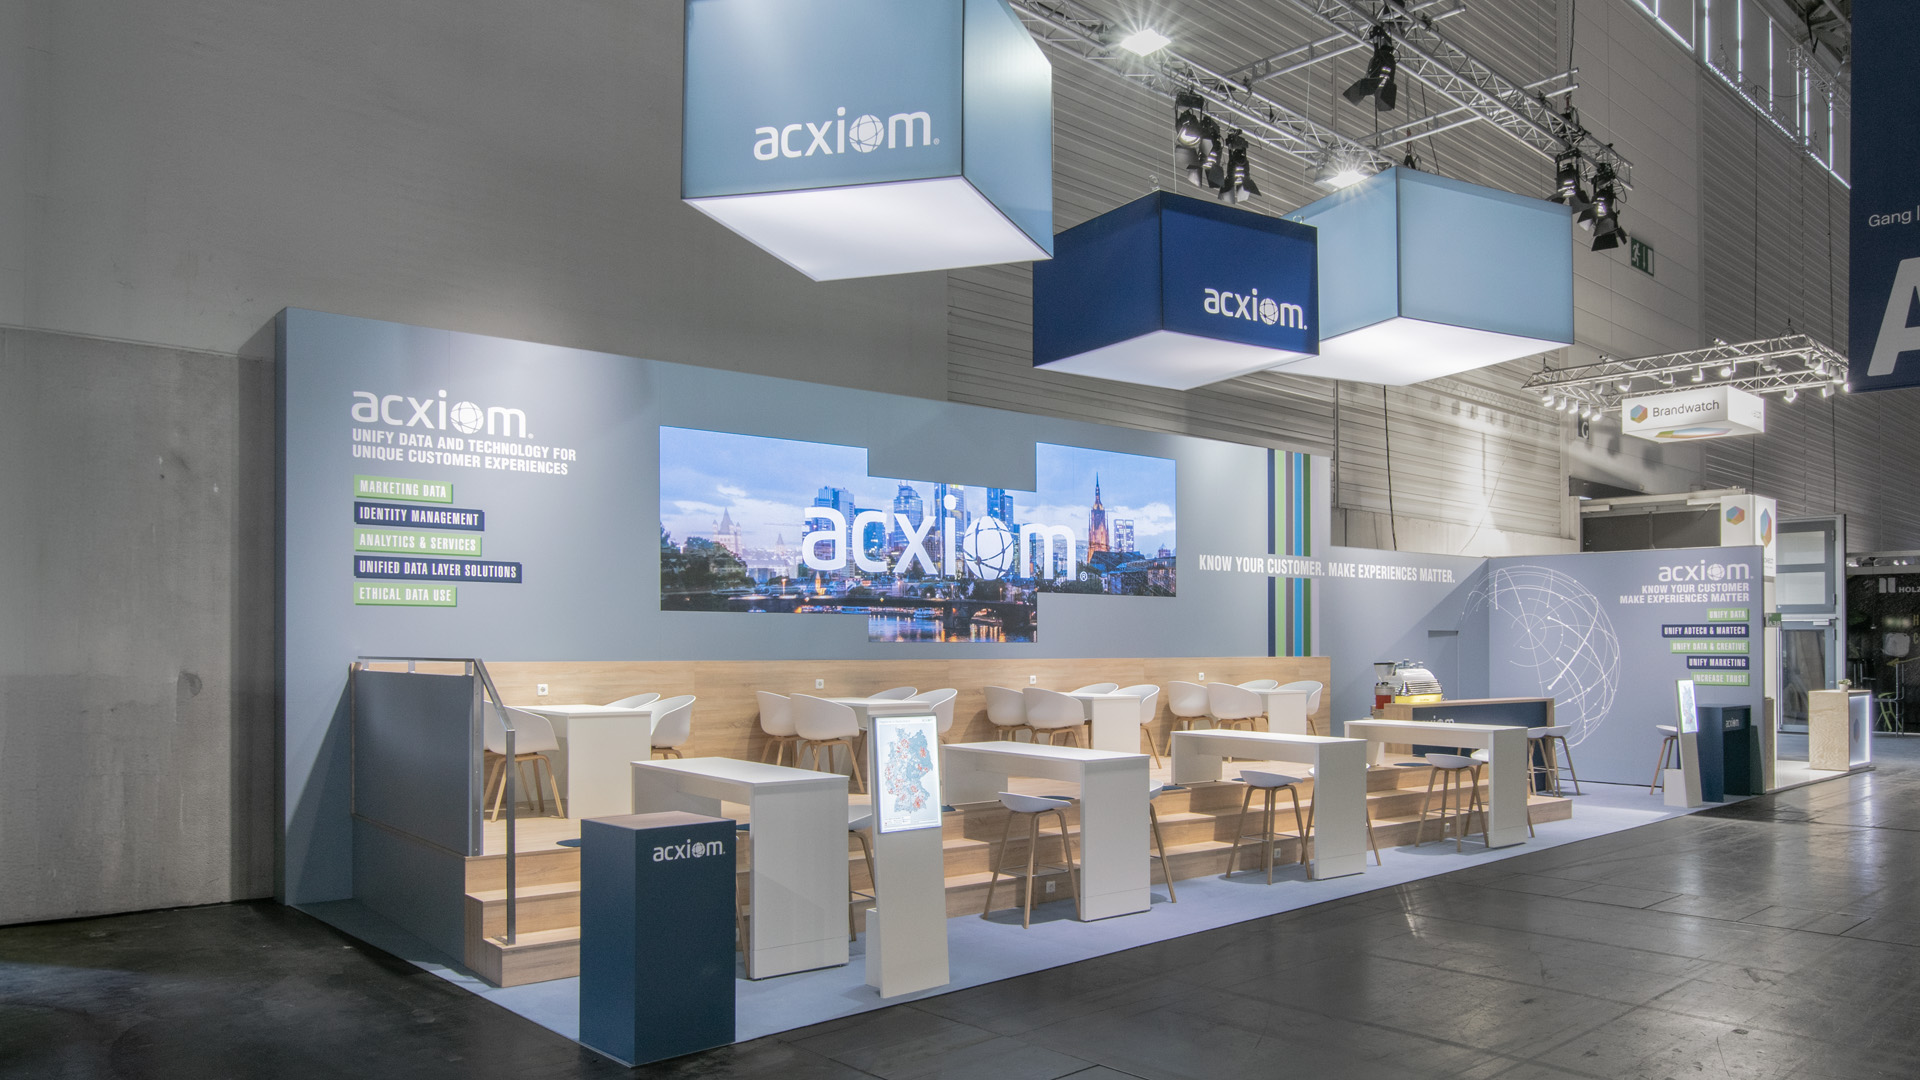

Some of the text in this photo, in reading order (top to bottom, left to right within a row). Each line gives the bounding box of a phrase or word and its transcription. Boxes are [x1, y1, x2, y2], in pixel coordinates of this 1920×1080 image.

[753, 106, 935, 161] acxiom
[1868, 210, 1912, 227] Gang
[1203, 287, 1305, 330] acxiom
[351, 389, 530, 439] acxiom
[1652, 399, 1720, 418] Brandwatch
[352, 428, 576, 461] UNIFY DATA AND TECHNOLOGY FOR
[352, 444, 568, 475] UNIQUE CUSTOMER EXPERIENCES
[360, 480, 447, 498] MARKETING DATA
[360, 506, 479, 526] IDENTITY MANAGEMENT
[359, 533, 476, 551] ANALYTICS & SERVICES
[802, 494, 1078, 581] acxiom
[359, 560, 517, 578] UNIFIED DATA LAYER SOLUTIONS
[1199, 554, 1456, 583] KNOW YOUR CUSTOMER. MAKE EXPERIENCES MATTER.
[1658, 560, 1750, 582] acxiom
[359, 587, 452, 602] ETHICAL DATA USE
[1641, 582, 1749, 594] KNOW YOUR CUSTOMER
[1620, 593, 1749, 604] MAKE EXPERIENCES MATTER
[1709, 610, 1746, 619] UNIFY DATA
[1664, 626, 1746, 635] UNIFY ADTECH & MARTECH
[1672, 642, 1746, 651] UNIFY DATA & CREATIVE
[1688, 659, 1746, 667] UNIFY MARKETING
[1693, 674, 1746, 683] INCREASE TRUST
[652, 838, 725, 862] acxiom
